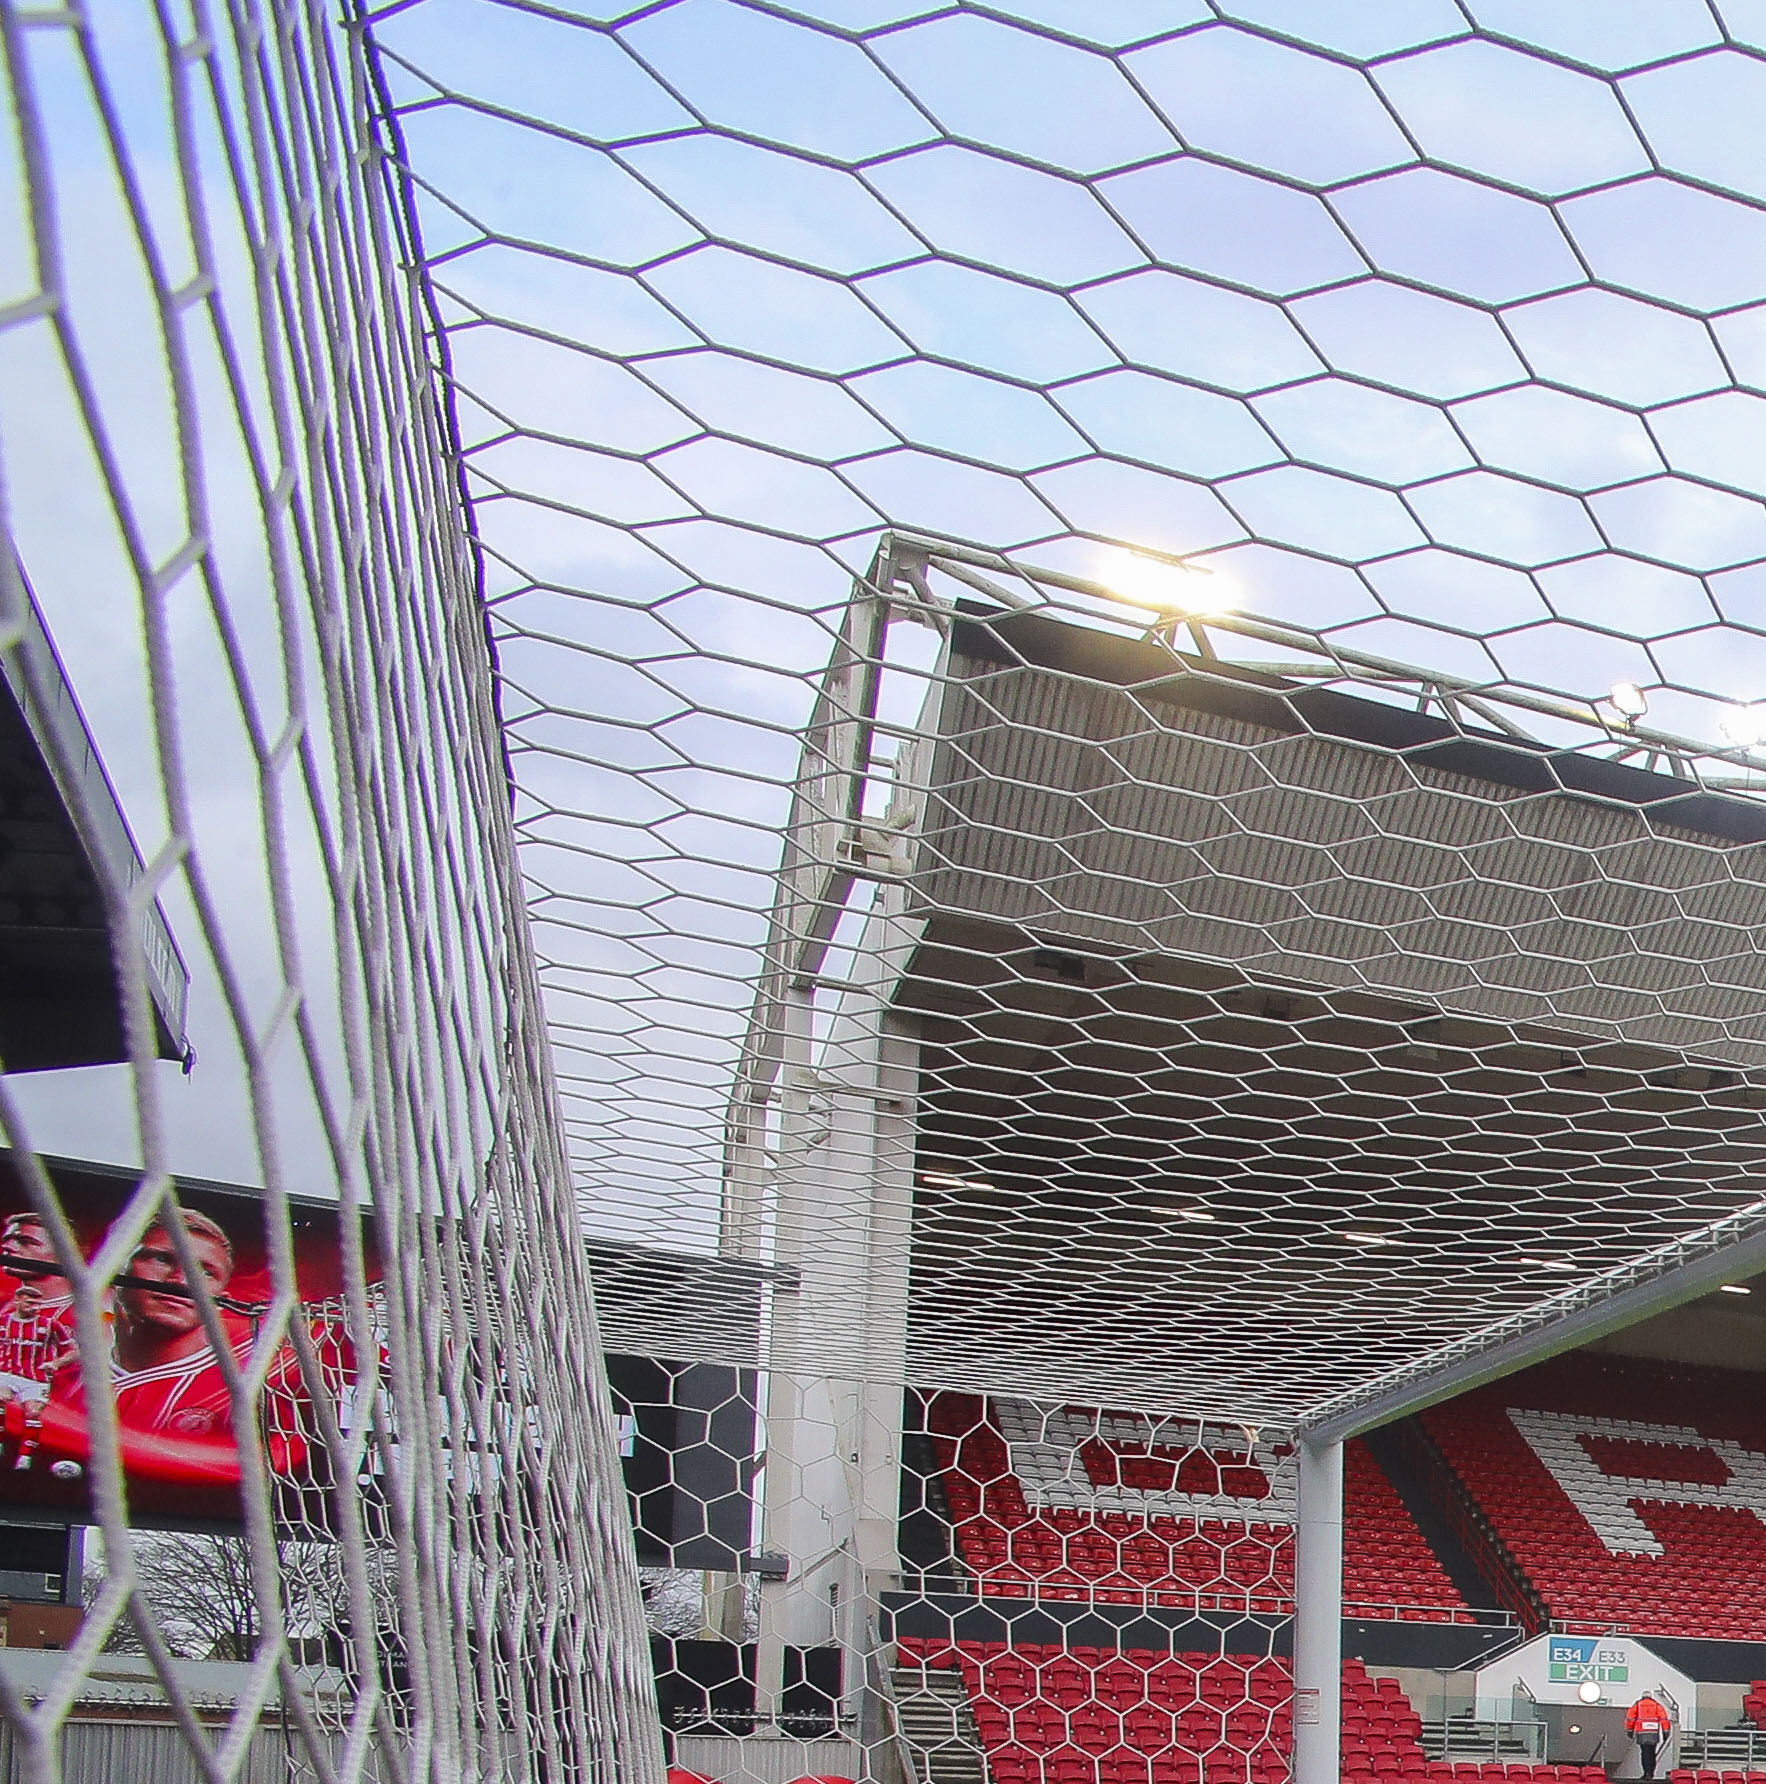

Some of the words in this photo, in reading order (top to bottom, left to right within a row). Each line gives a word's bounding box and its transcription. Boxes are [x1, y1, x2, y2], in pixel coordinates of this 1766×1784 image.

[1553, 1648, 1582, 1661] E34
[1600, 1651, 1626, 1663] E33
[1566, 1665, 1614, 1680] EXIT
